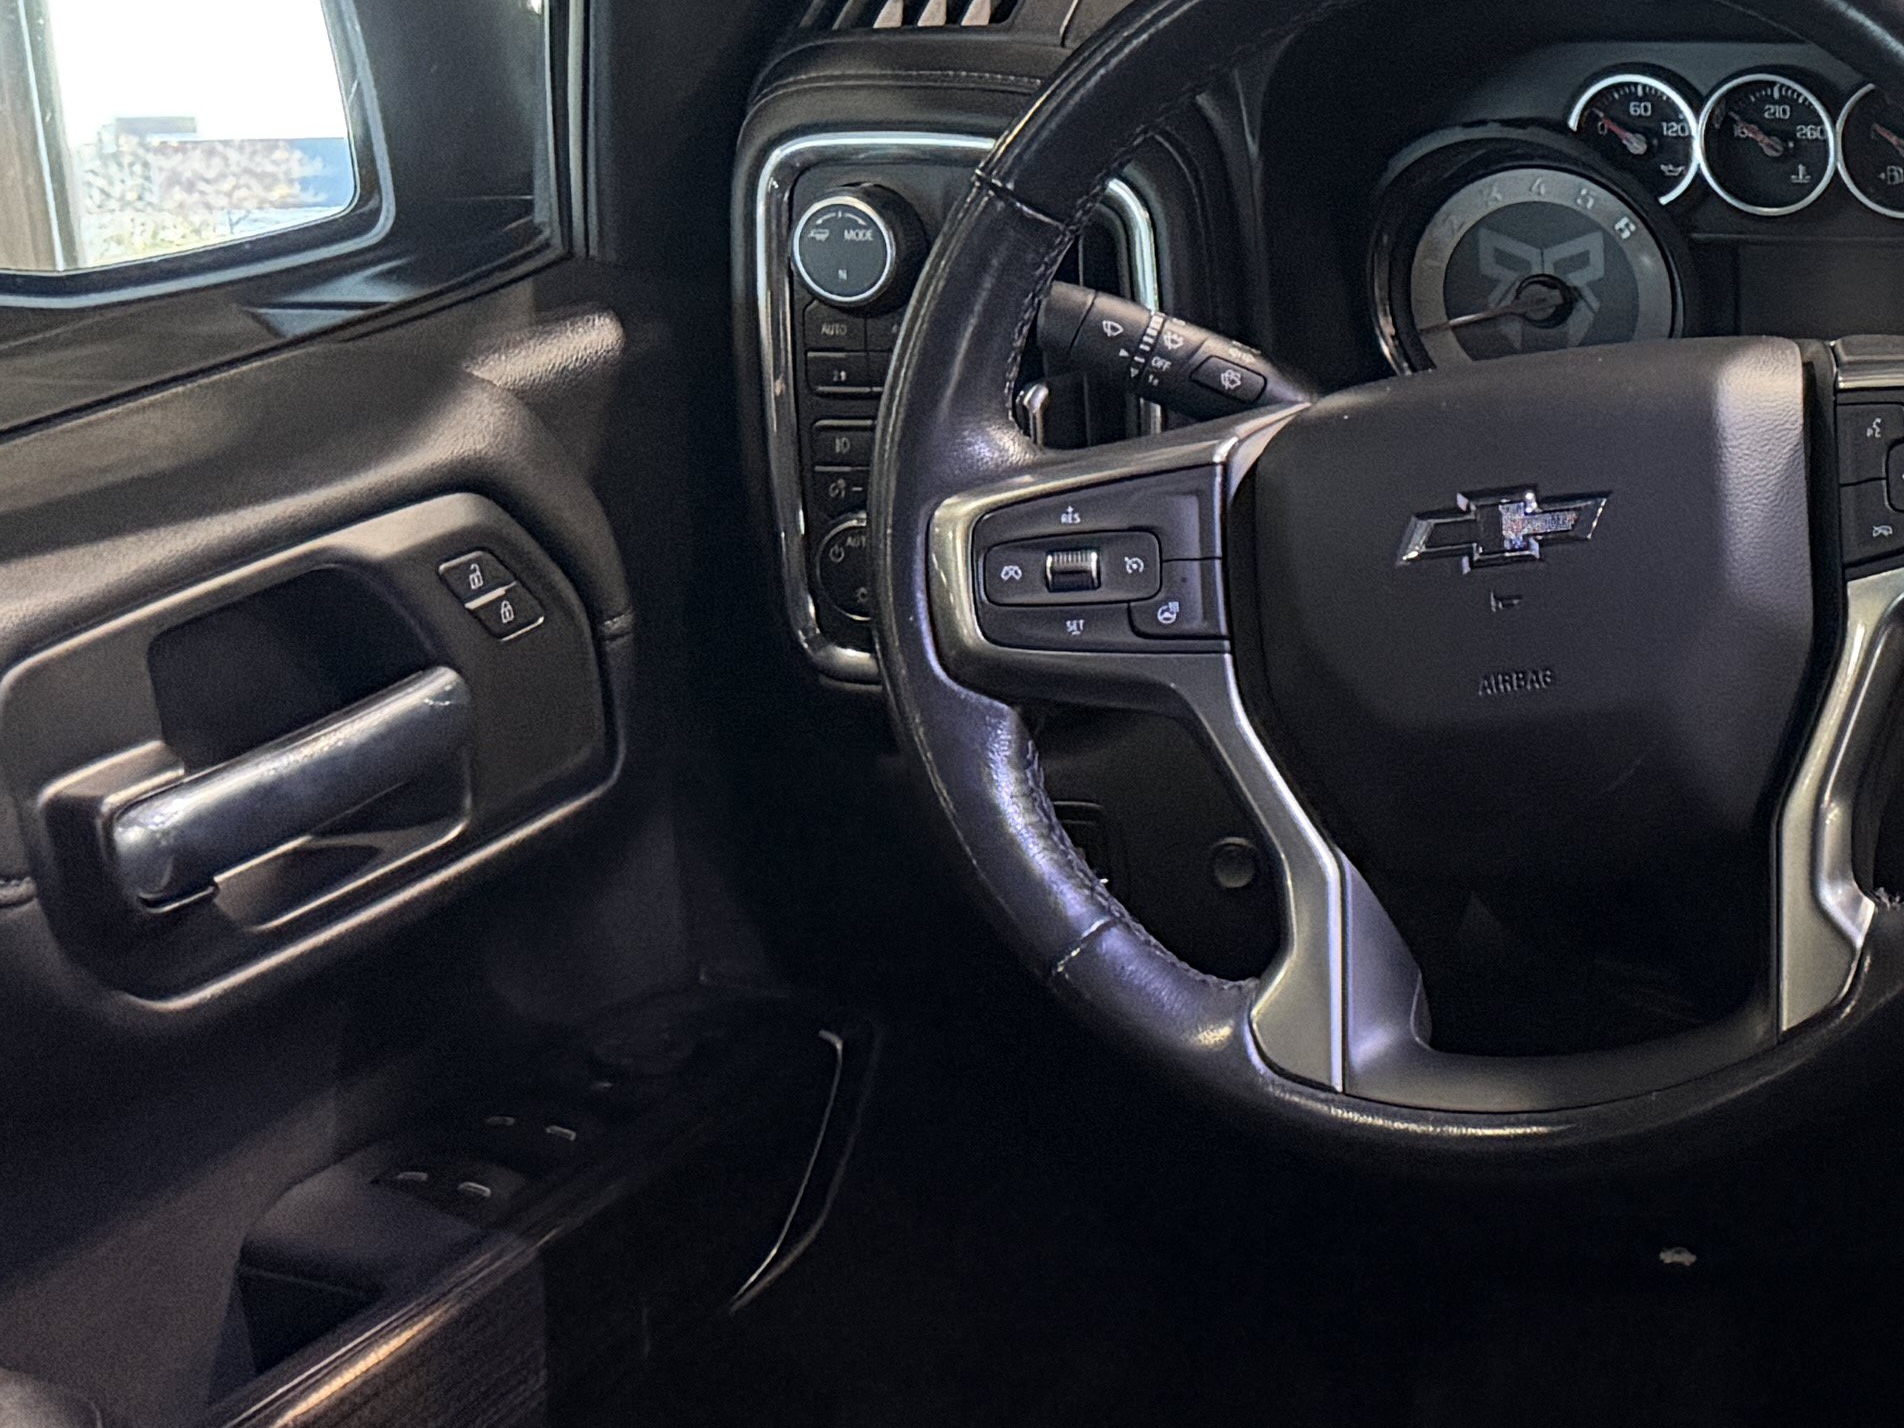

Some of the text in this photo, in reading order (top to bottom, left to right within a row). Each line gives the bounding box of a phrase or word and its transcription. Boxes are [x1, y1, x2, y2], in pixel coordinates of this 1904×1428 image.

[1629, 101, 1652, 116] 60
[1765, 104, 1791, 120] 210
[1662, 122, 1690, 137] 120
[1796, 124, 1827, 140] 260
[844, 229, 874, 241] MODE
[820, 323, 848, 336] AUTO
[1061, 513, 1081, 524] RES
[1066, 620, 1085, 632] SET
[1477, 669, 1553, 696] AIRBAG
